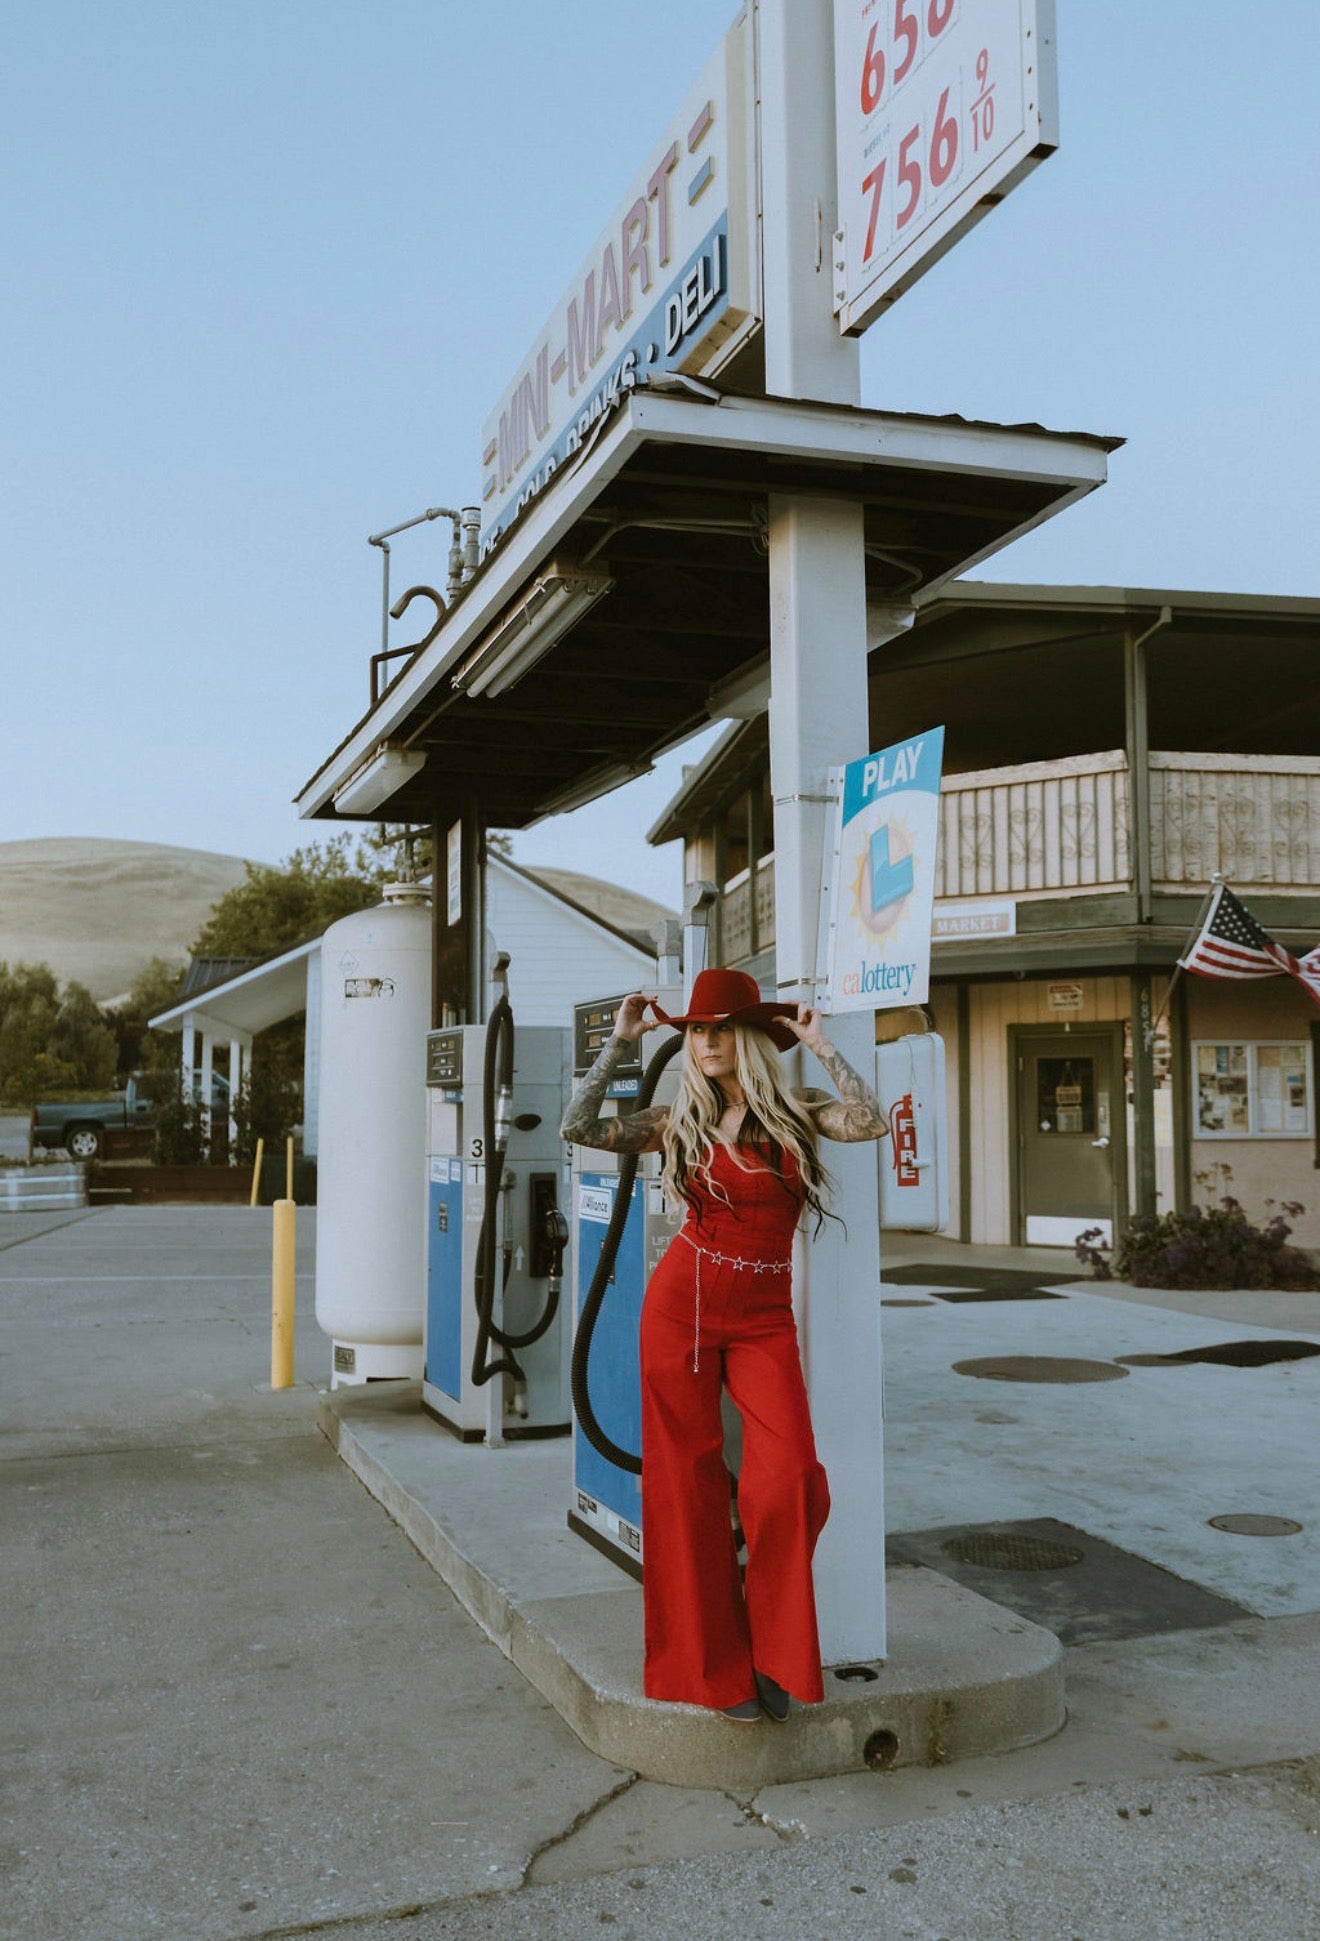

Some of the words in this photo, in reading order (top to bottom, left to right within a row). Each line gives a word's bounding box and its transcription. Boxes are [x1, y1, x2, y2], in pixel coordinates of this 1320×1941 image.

[862, 86, 959, 263] 756
[499, 139, 679, 494] MINI-MART
[665, 234, 727, 356] DELI
[862, 741, 925, 798] PLAY
[936, 916, 1000, 933] MARKET
[471, 1138, 483, 1158] 3
[900, 1119, 917, 1178] FIRE
